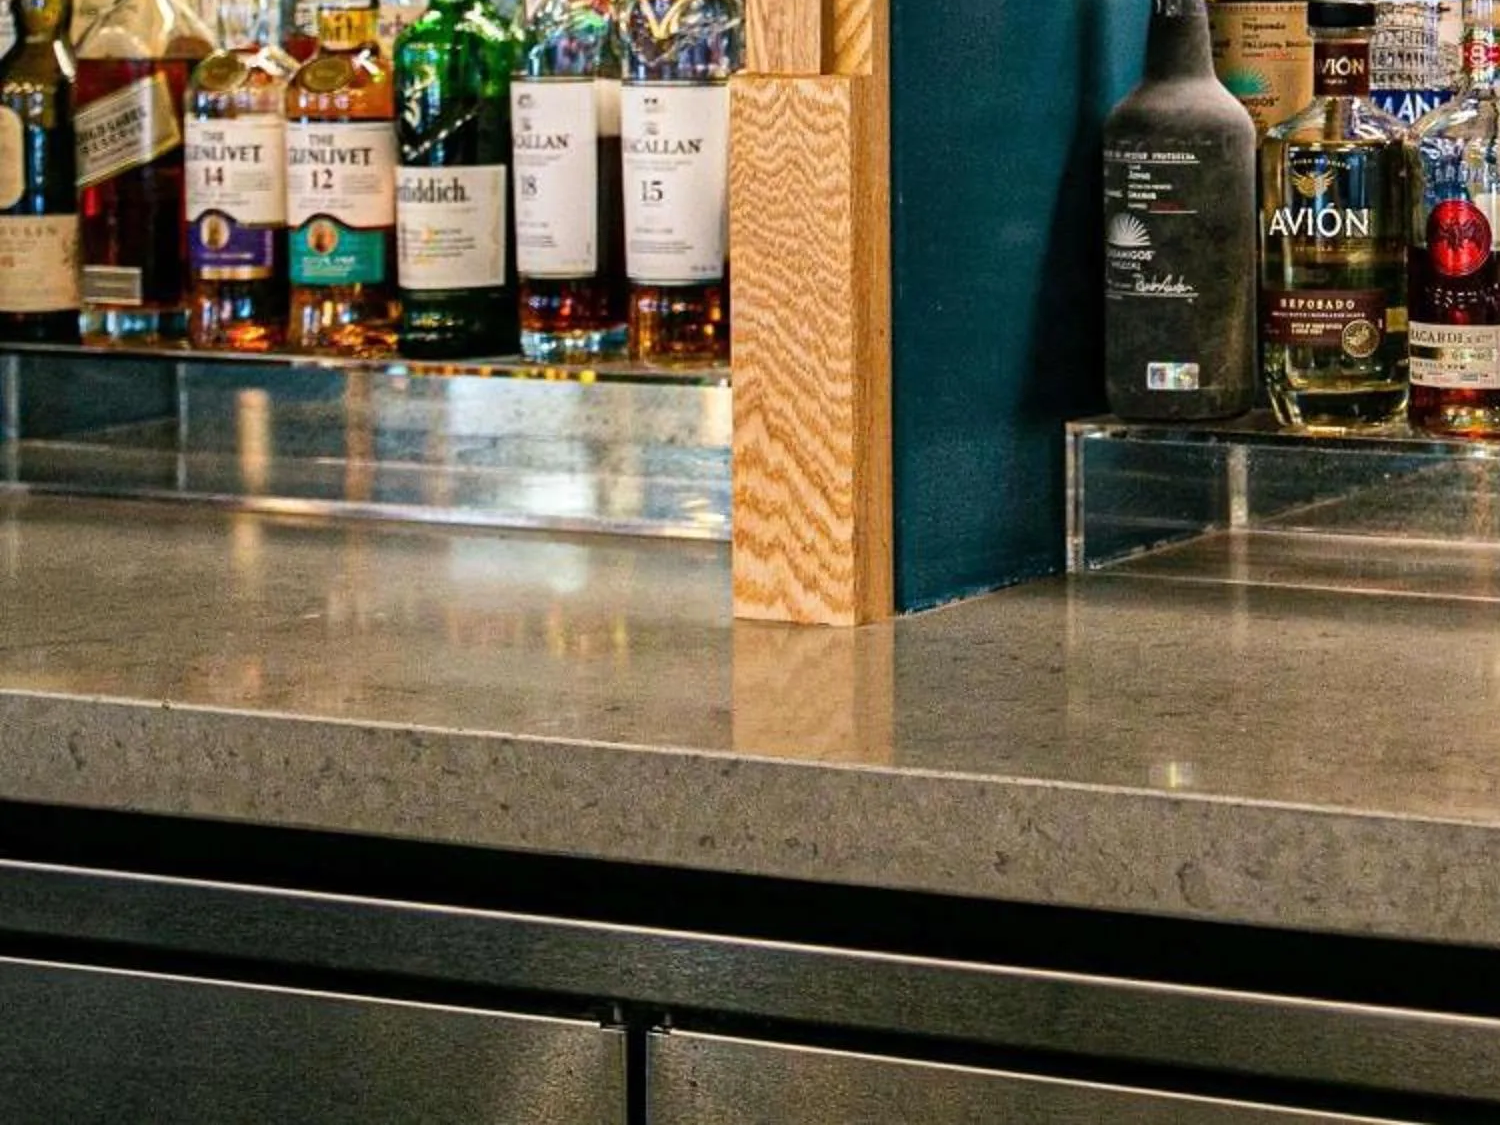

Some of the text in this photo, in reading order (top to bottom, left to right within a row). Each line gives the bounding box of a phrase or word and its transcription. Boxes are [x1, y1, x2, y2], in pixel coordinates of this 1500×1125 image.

[312, 168, 333, 189] 12
[640, 180, 664, 202] 15
[1269, 202, 1369, 237] AVIÓN
[1280, 298, 1355, 309] REPOSADO
